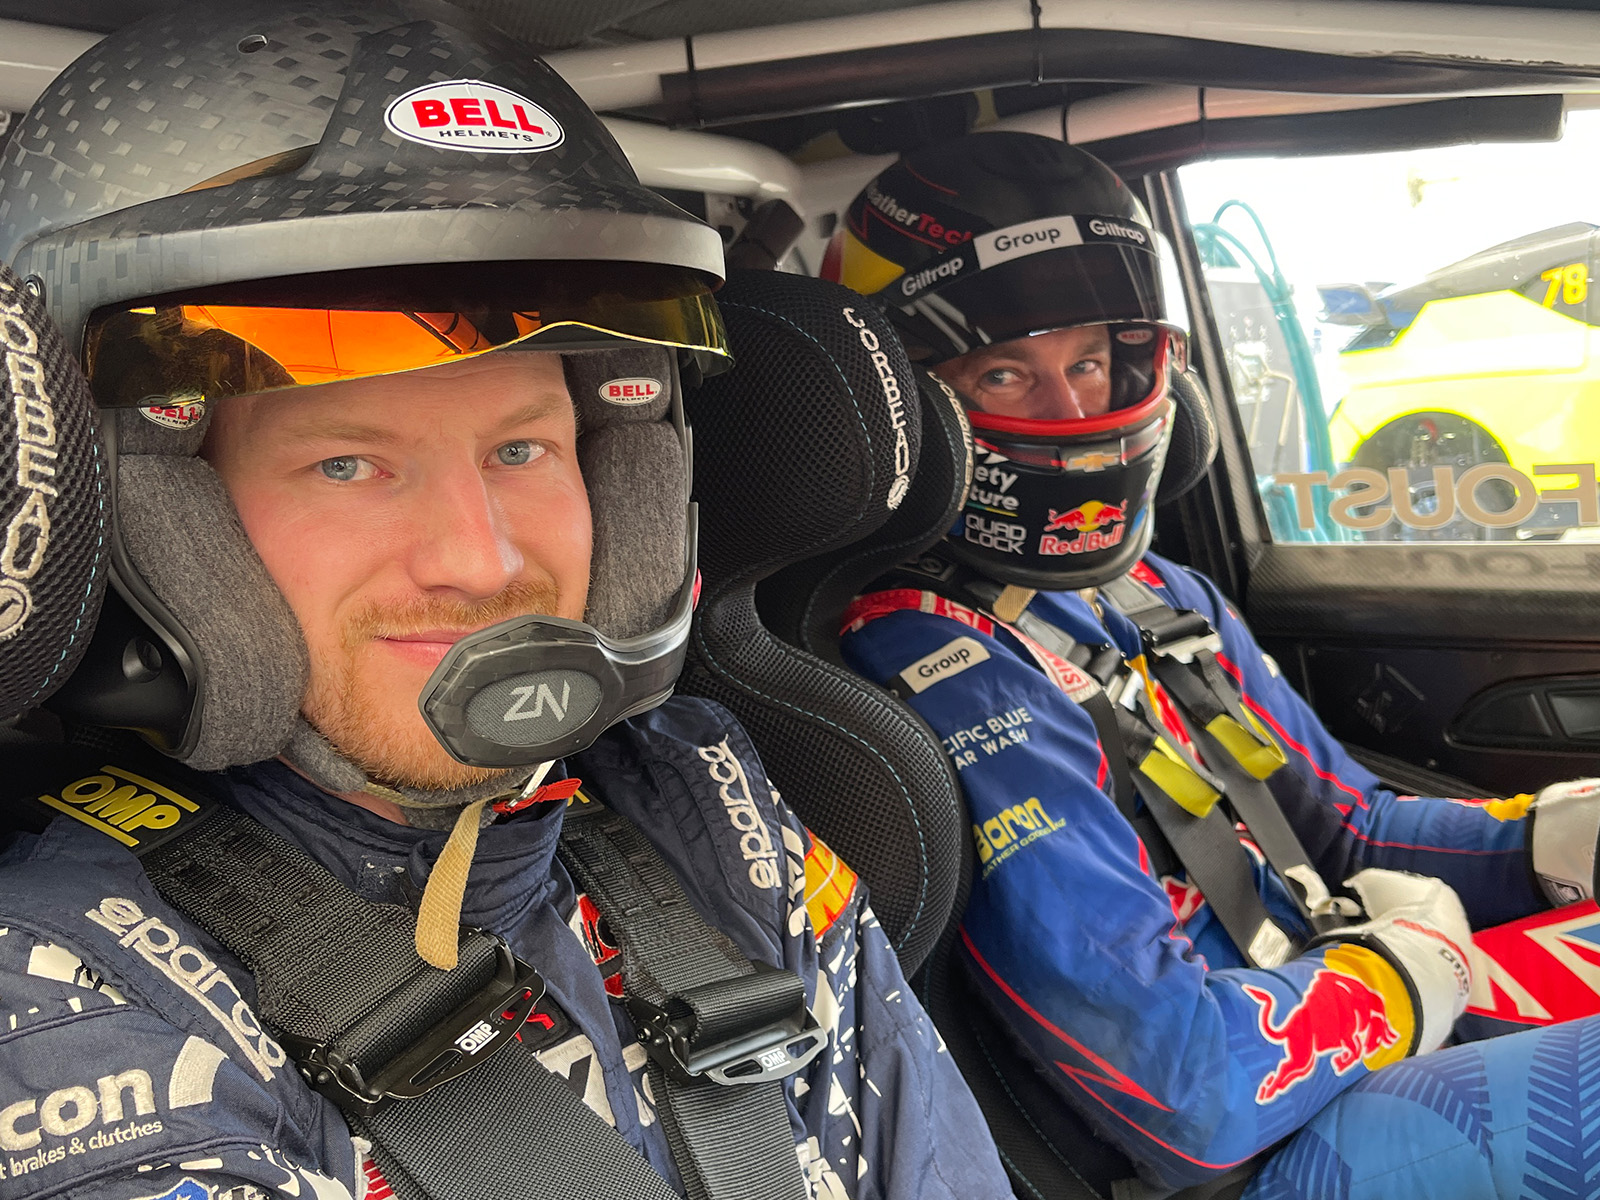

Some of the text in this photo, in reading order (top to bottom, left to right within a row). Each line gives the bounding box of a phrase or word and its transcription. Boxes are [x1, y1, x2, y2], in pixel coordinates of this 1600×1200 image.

[412, 98, 544, 135] BELL
[439, 129, 533, 142] HELMETS
[901, 219, 1146, 297] Giltrap Group Giltrap
[1541, 263, 1588, 309] 78
[608, 384, 655, 397] BELL
[974, 466, 1019, 494] ety
[969, 485, 1020, 510] ture
[965, 513, 1027, 542] QUAD
[1038, 523, 1126, 555] Red Bull
[964, 529, 1025, 556] LOCK
[917, 648, 971, 678] Group
[986, 707, 1034, 735] BLUE
[981, 727, 1030, 756] WASH
[61, 775, 181, 832] OMP
[698, 733, 782, 889] sparco
[85, 897, 287, 1081] sparco
[460, 1023, 495, 1052] OMP
[760, 1048, 786, 1069] OMP
[0, 1068, 156, 1152] con
[10, 1146, 66, 1177] brakes
[68, 1137, 87, 1155] &
[88, 1120, 163, 1150] clutches
